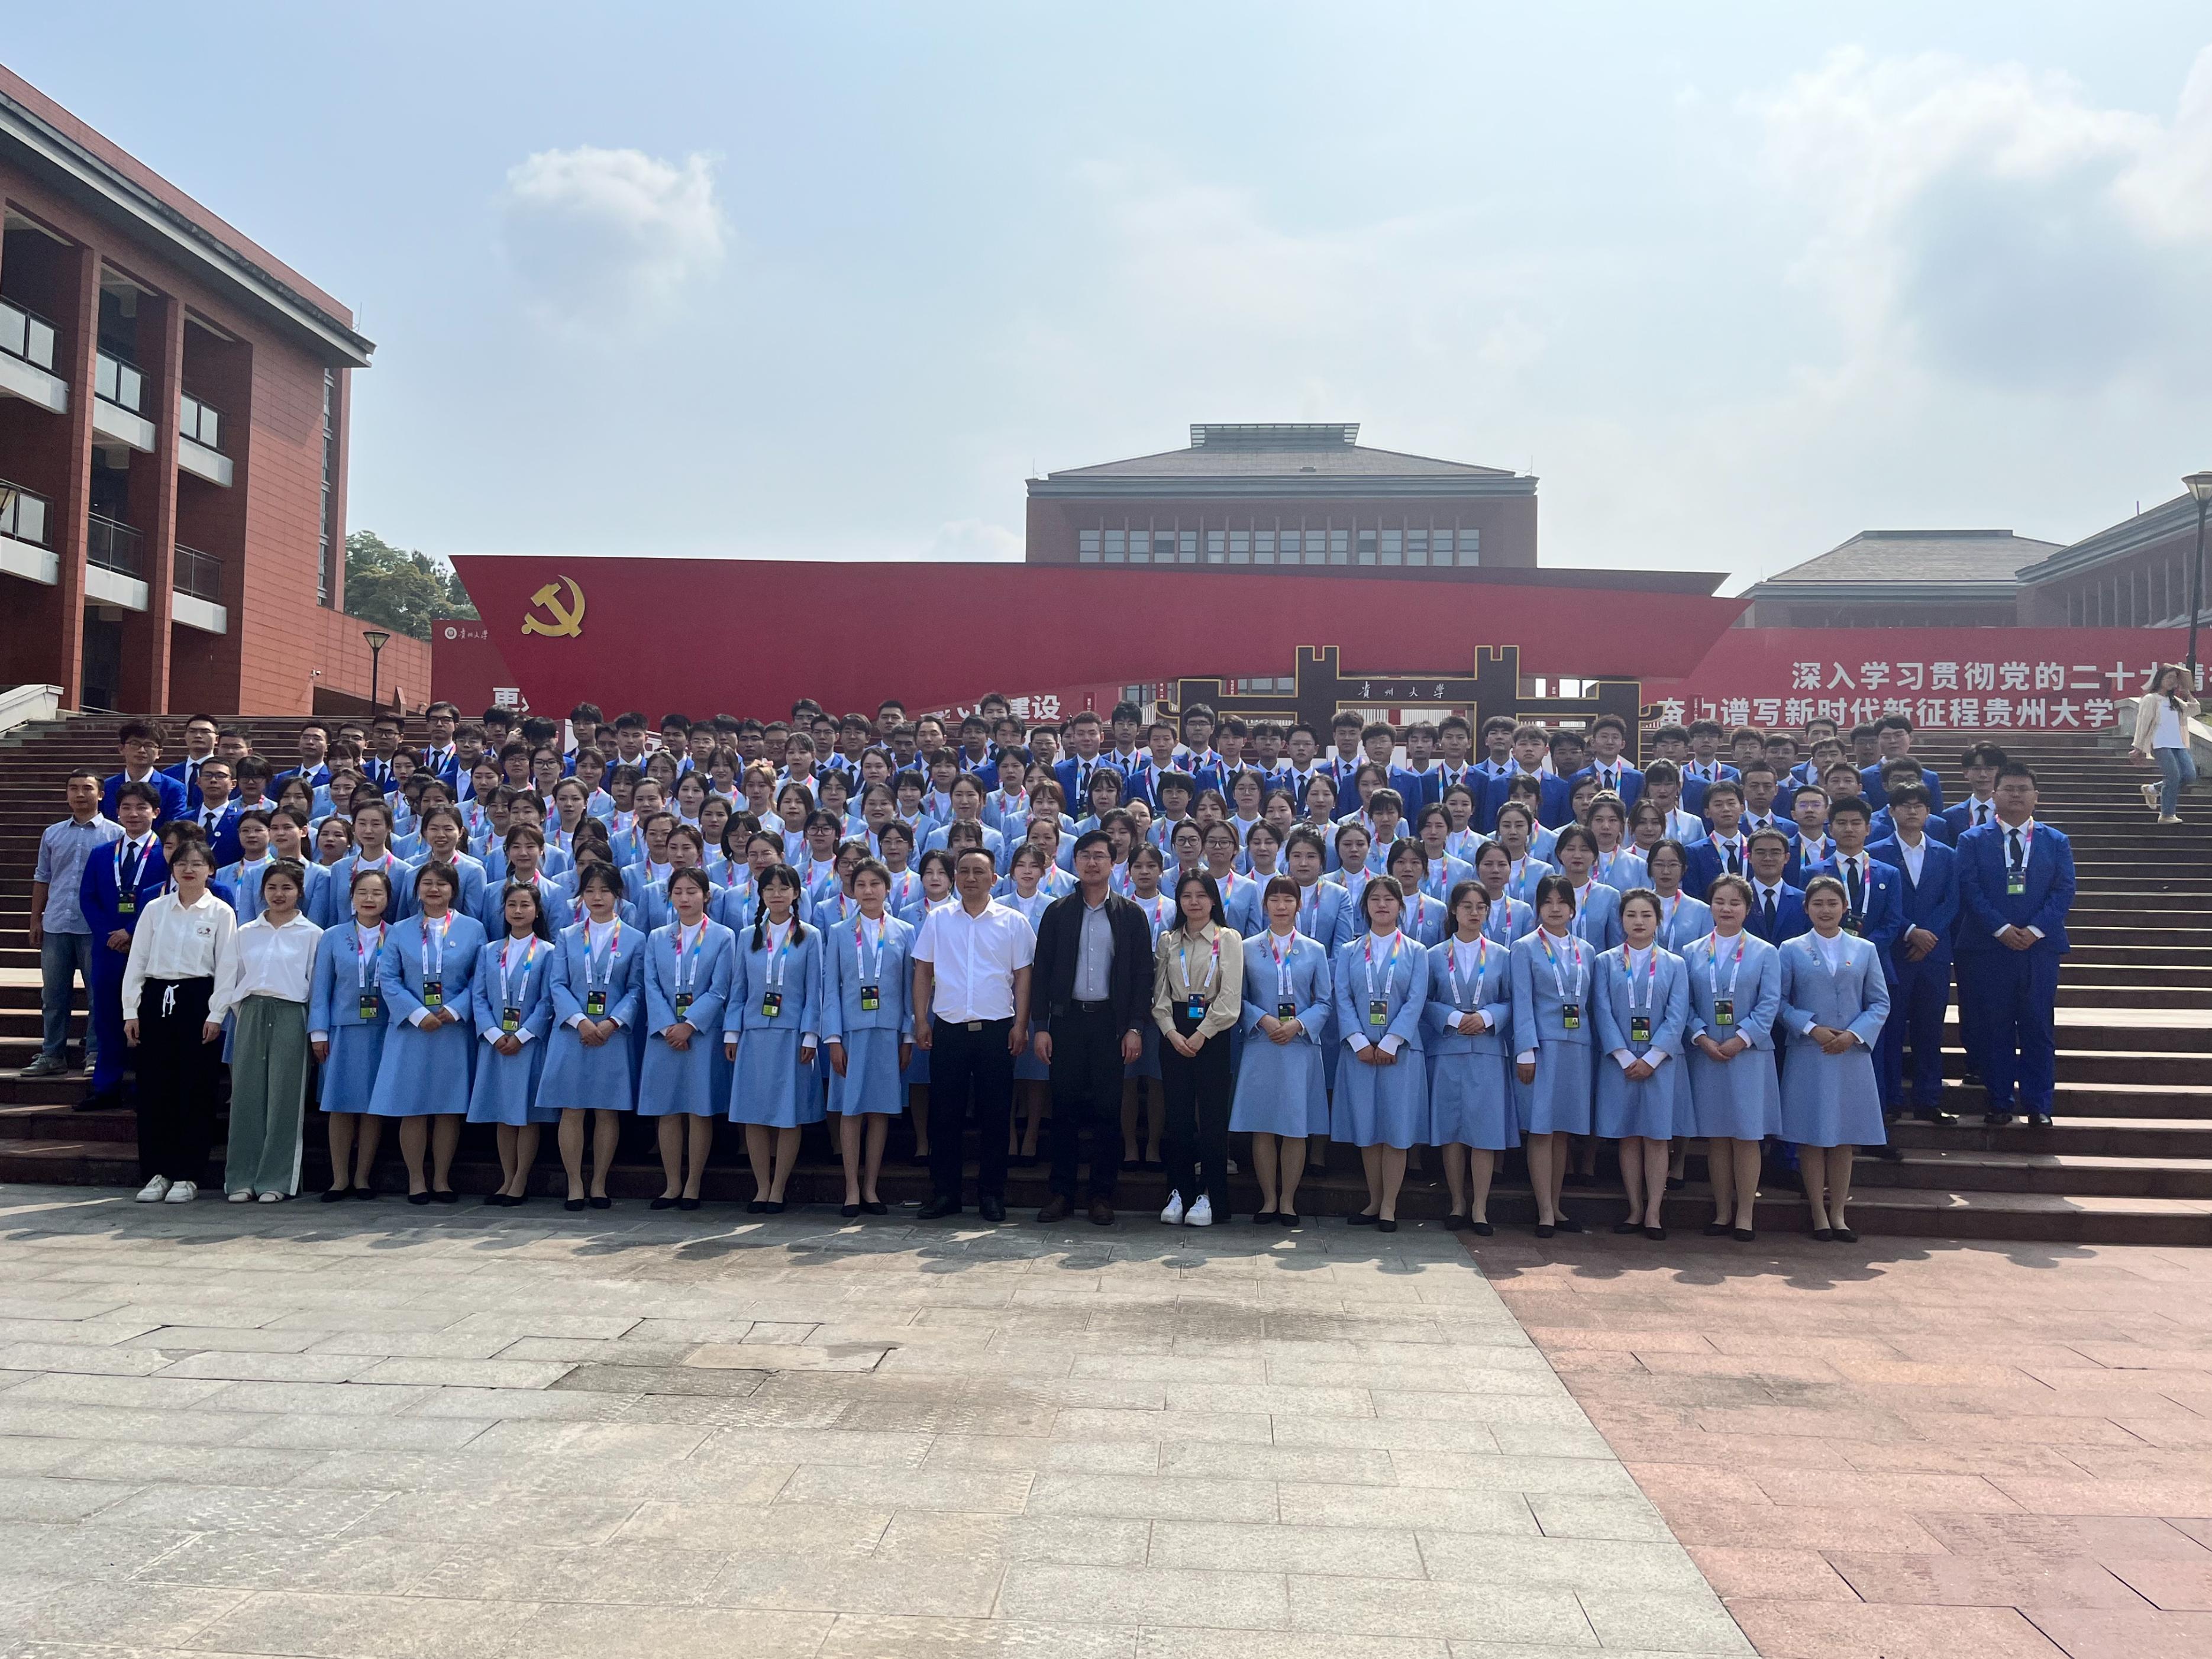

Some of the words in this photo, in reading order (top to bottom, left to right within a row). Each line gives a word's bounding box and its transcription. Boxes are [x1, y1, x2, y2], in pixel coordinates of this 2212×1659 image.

[1792, 661, 2212, 691] 深入学习贯彻党的二十大
